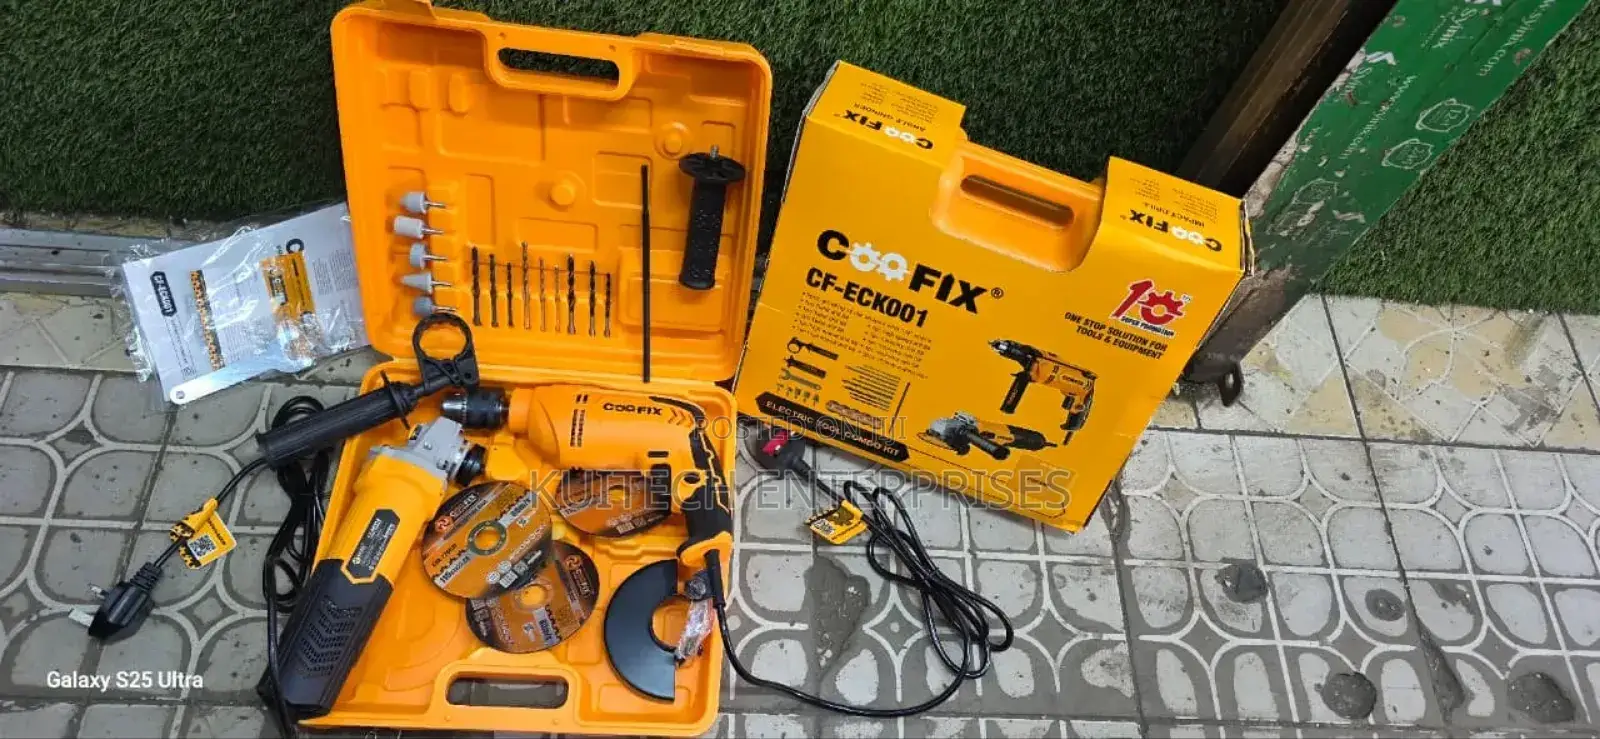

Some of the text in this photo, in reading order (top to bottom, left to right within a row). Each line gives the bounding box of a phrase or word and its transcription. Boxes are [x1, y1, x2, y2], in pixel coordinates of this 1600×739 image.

[806, 267, 929, 328] CF-ECK001
[1064, 312, 1169, 351] ONE STOP SOLUTION FOR
[1076, 326, 1164, 360] TOOLS & EQUIPMENT
[766, 400, 814, 425] ELECTRIC
[883, 444, 900, 456] KIT
